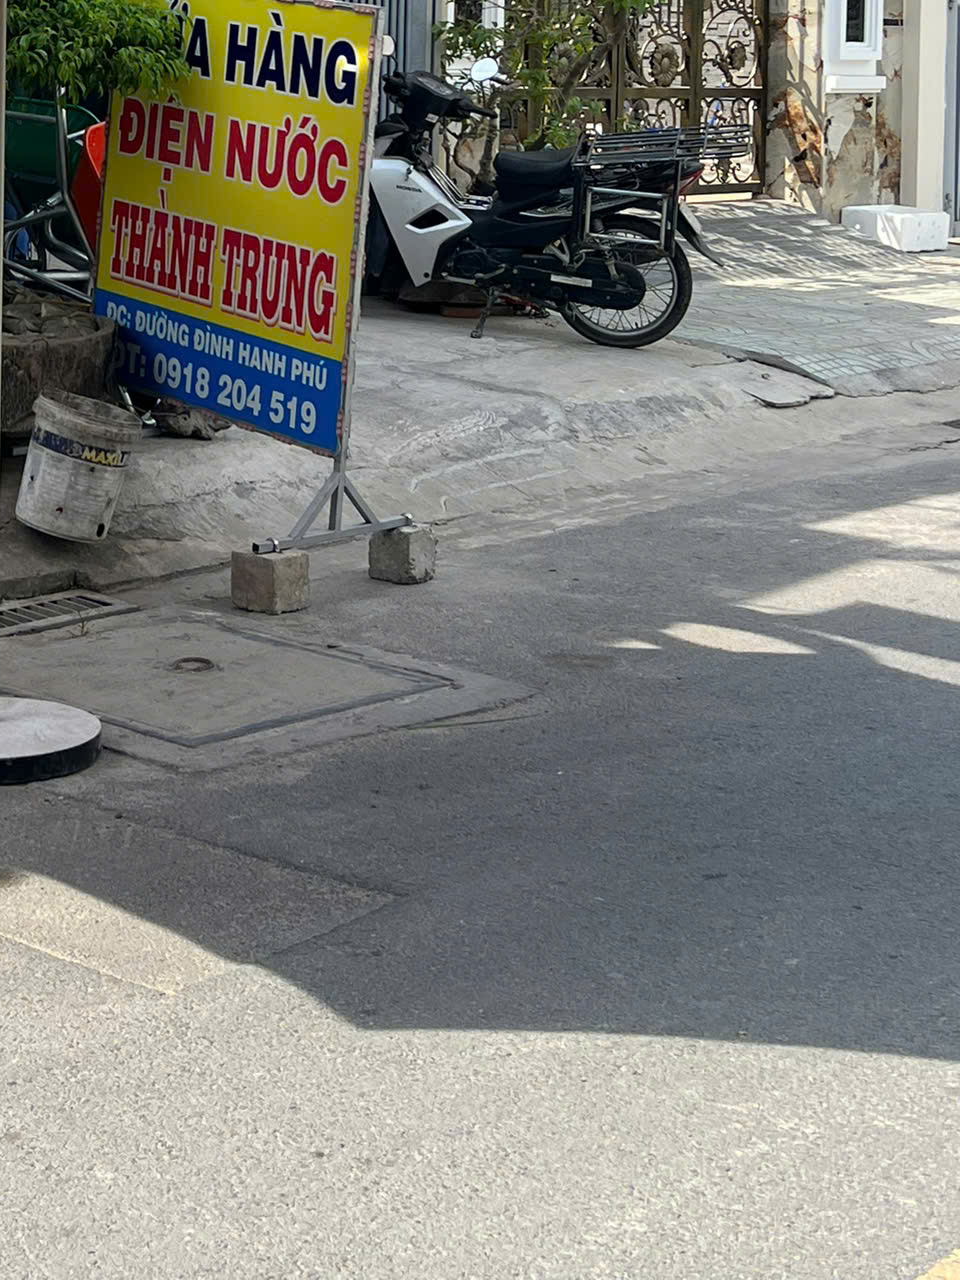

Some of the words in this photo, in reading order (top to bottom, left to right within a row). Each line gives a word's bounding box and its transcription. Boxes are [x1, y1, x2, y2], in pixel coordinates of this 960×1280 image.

[225, 11, 357, 106] HÀNG
[119, 94, 215, 183] ĐIỆN
[225, 116, 348, 202] NƯỚC
[110, 188, 217, 304] THÀNH
[221, 226, 337, 341] TRUNG
[135, 310, 189, 348] ĐƯỜNG
[193, 322, 234, 361] ĐÌNH
[238, 342, 286, 377] HANH
[291, 357, 327, 391] PHÚ
[153, 352, 210, 399] 0918
[217, 374, 261, 417] 204
[269, 391, 316, 434] 519
